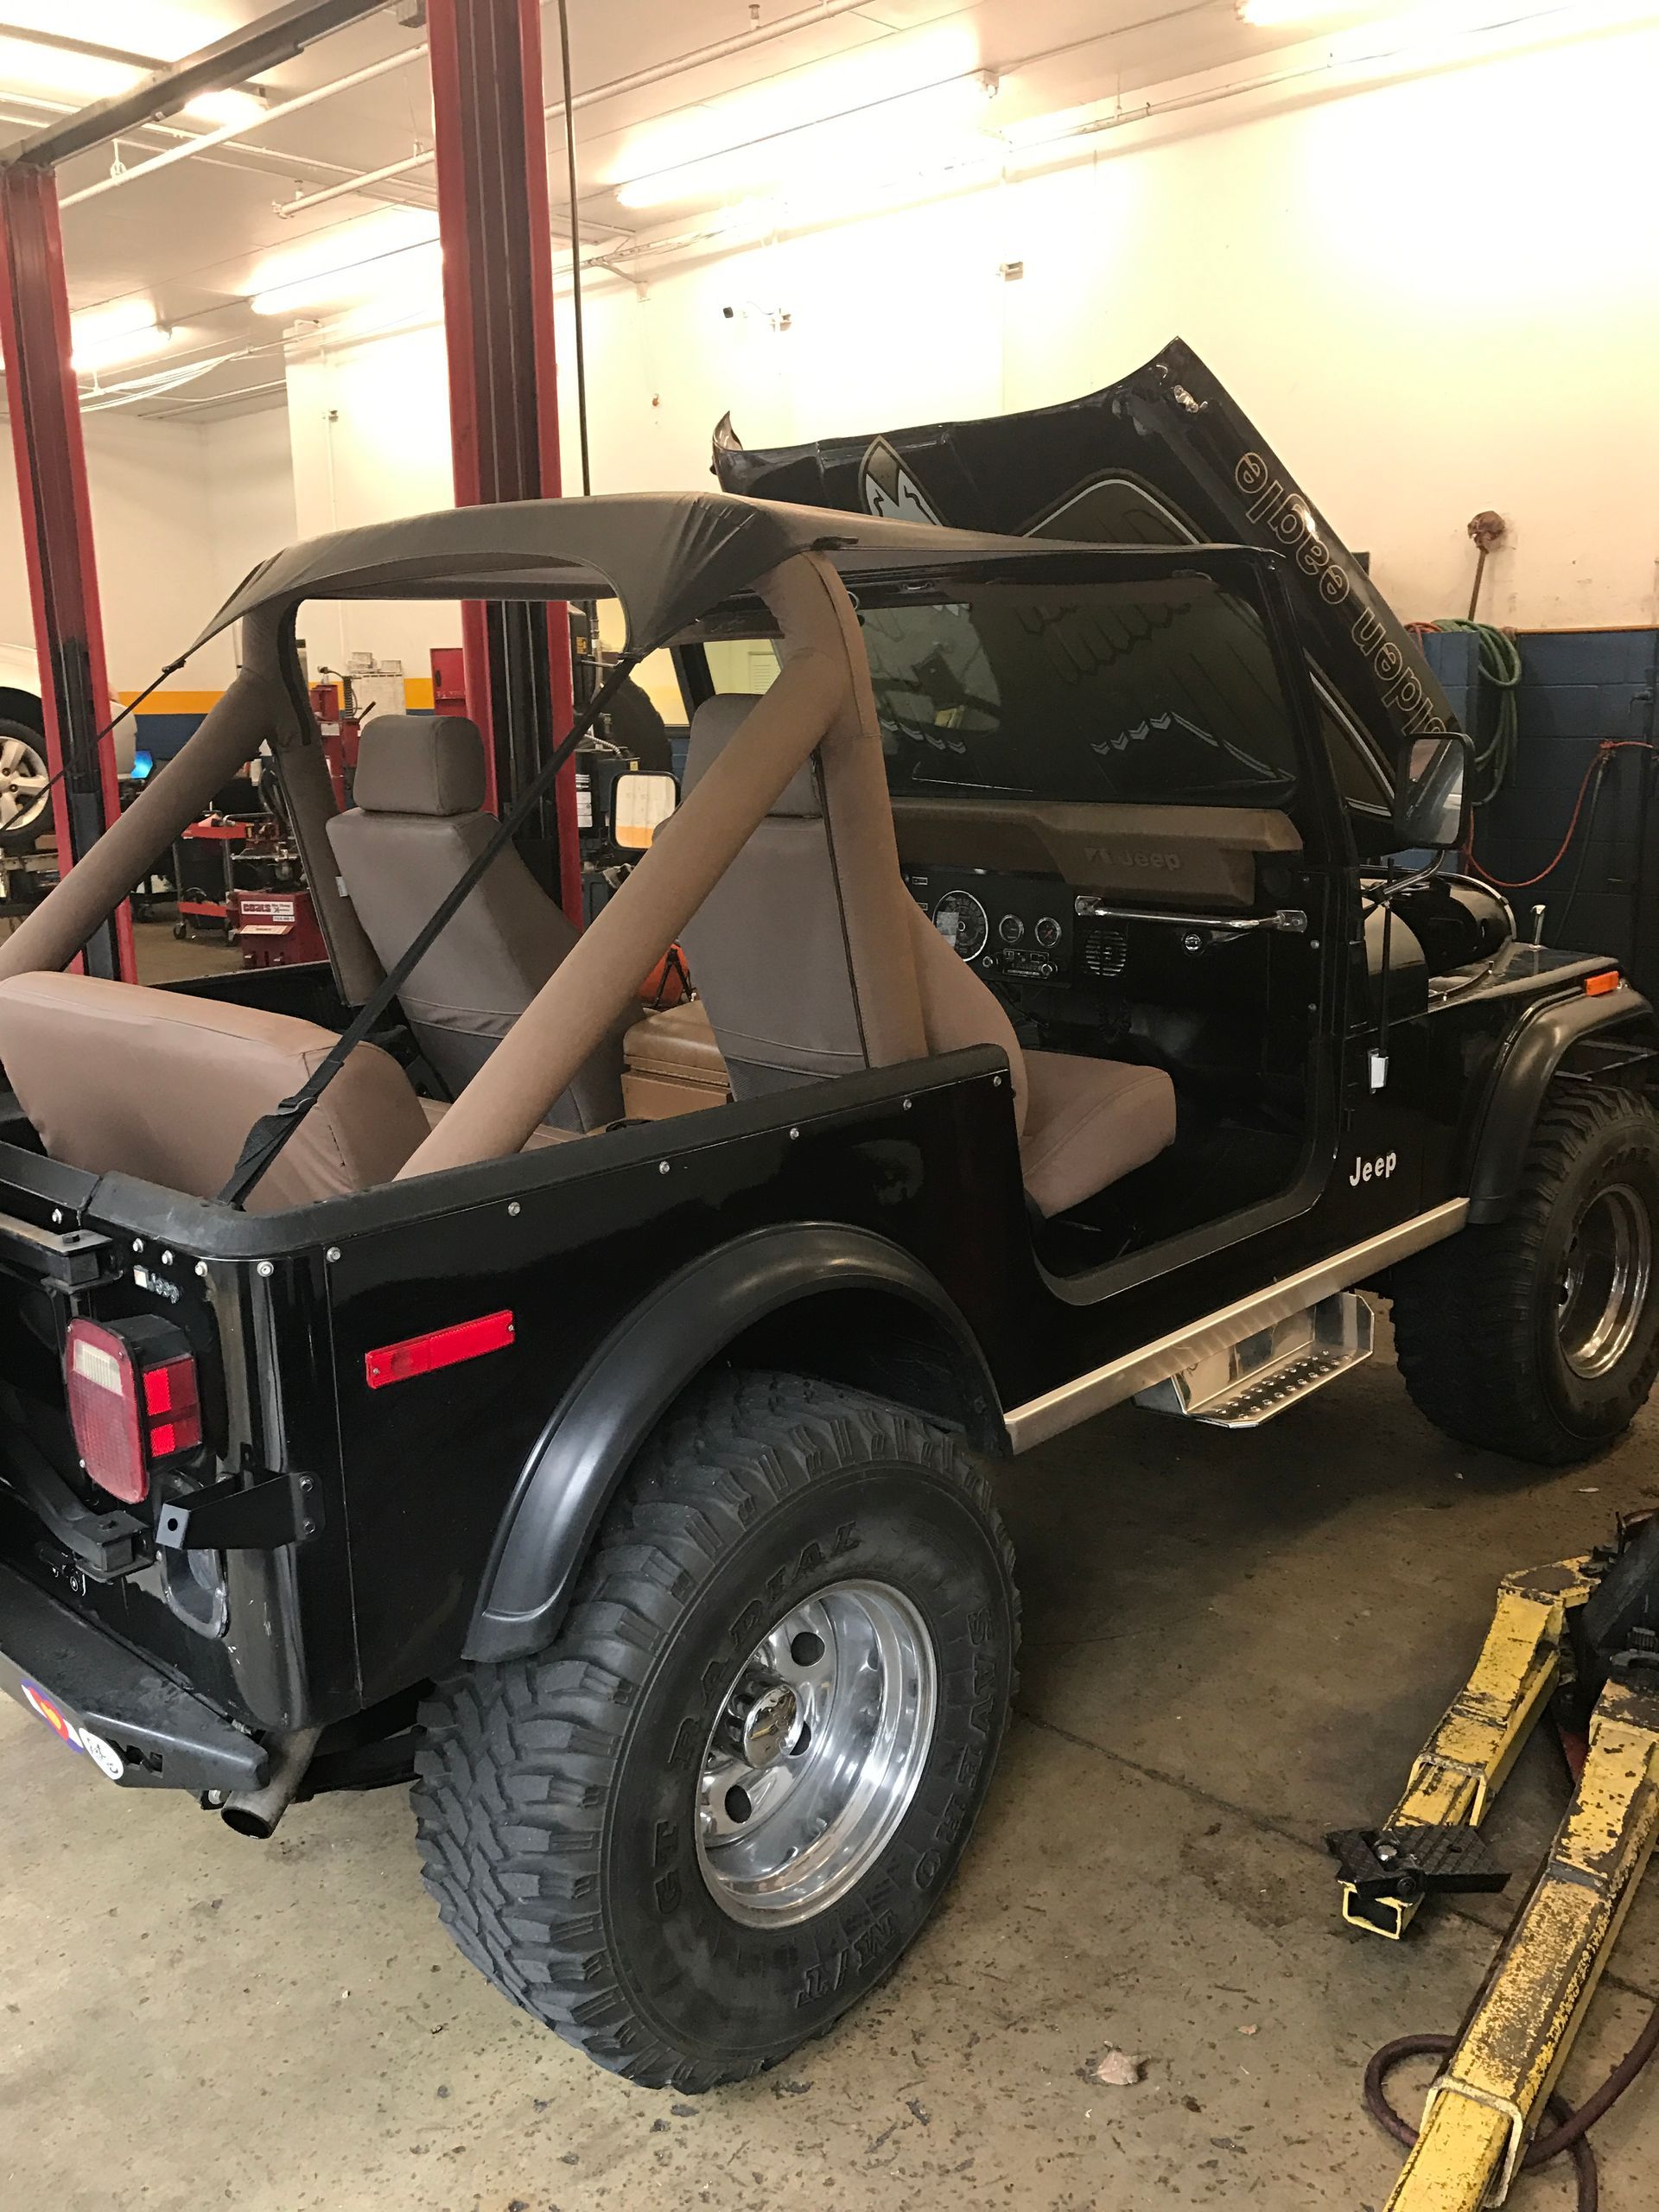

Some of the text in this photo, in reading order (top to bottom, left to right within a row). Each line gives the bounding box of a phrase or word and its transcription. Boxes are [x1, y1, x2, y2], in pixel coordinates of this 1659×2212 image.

[1235, 452, 1350, 605] eagle
[1121, 850, 1181, 871] Jeep
[1349, 1152, 1397, 1187] Jeep
[654, 1521, 861, 1916] GT RADIAL
[912, 1609, 995, 1891] SAVERO
